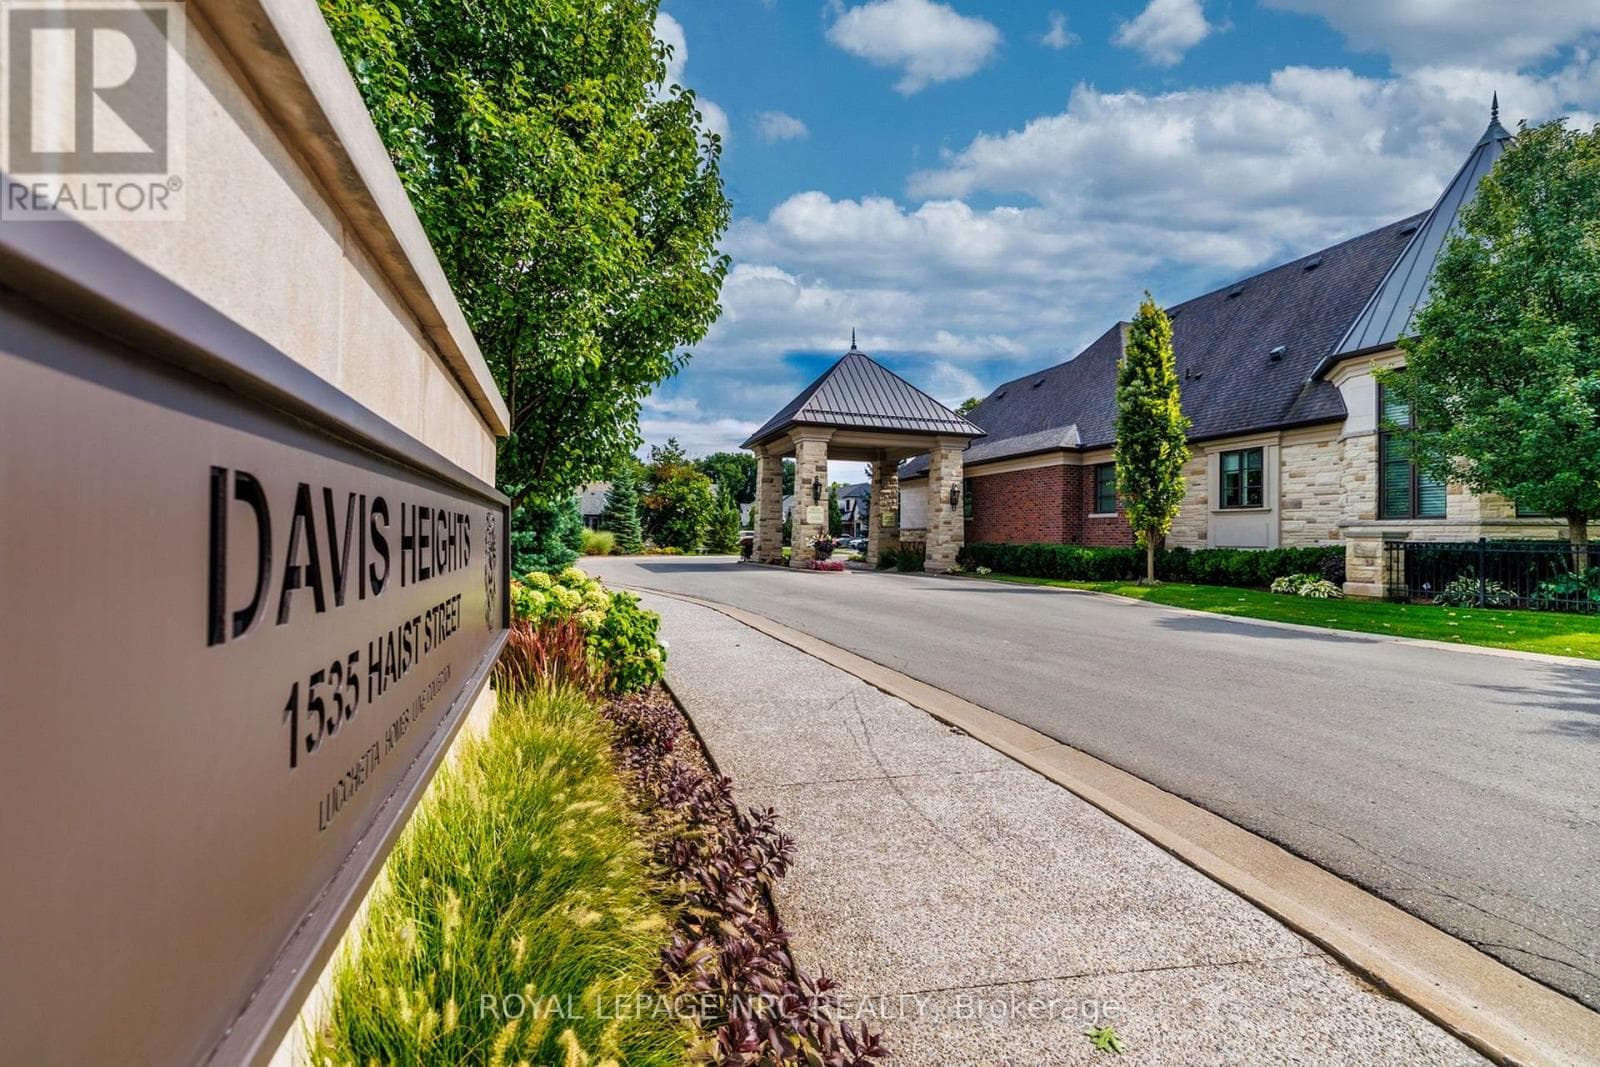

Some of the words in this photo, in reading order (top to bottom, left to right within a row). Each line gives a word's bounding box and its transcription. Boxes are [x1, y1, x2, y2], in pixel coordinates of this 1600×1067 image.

[207, 465, 391, 647] DAVIS
[401, 502, 471, 587] HEIGHTS
[283, 650, 360, 768] 1535
[368, 615, 421, 703] HAIST
[424, 593, 462, 654] STREET
[319, 740, 381, 832] LUCCHETTA
[385, 708, 410, 755] HOMES
